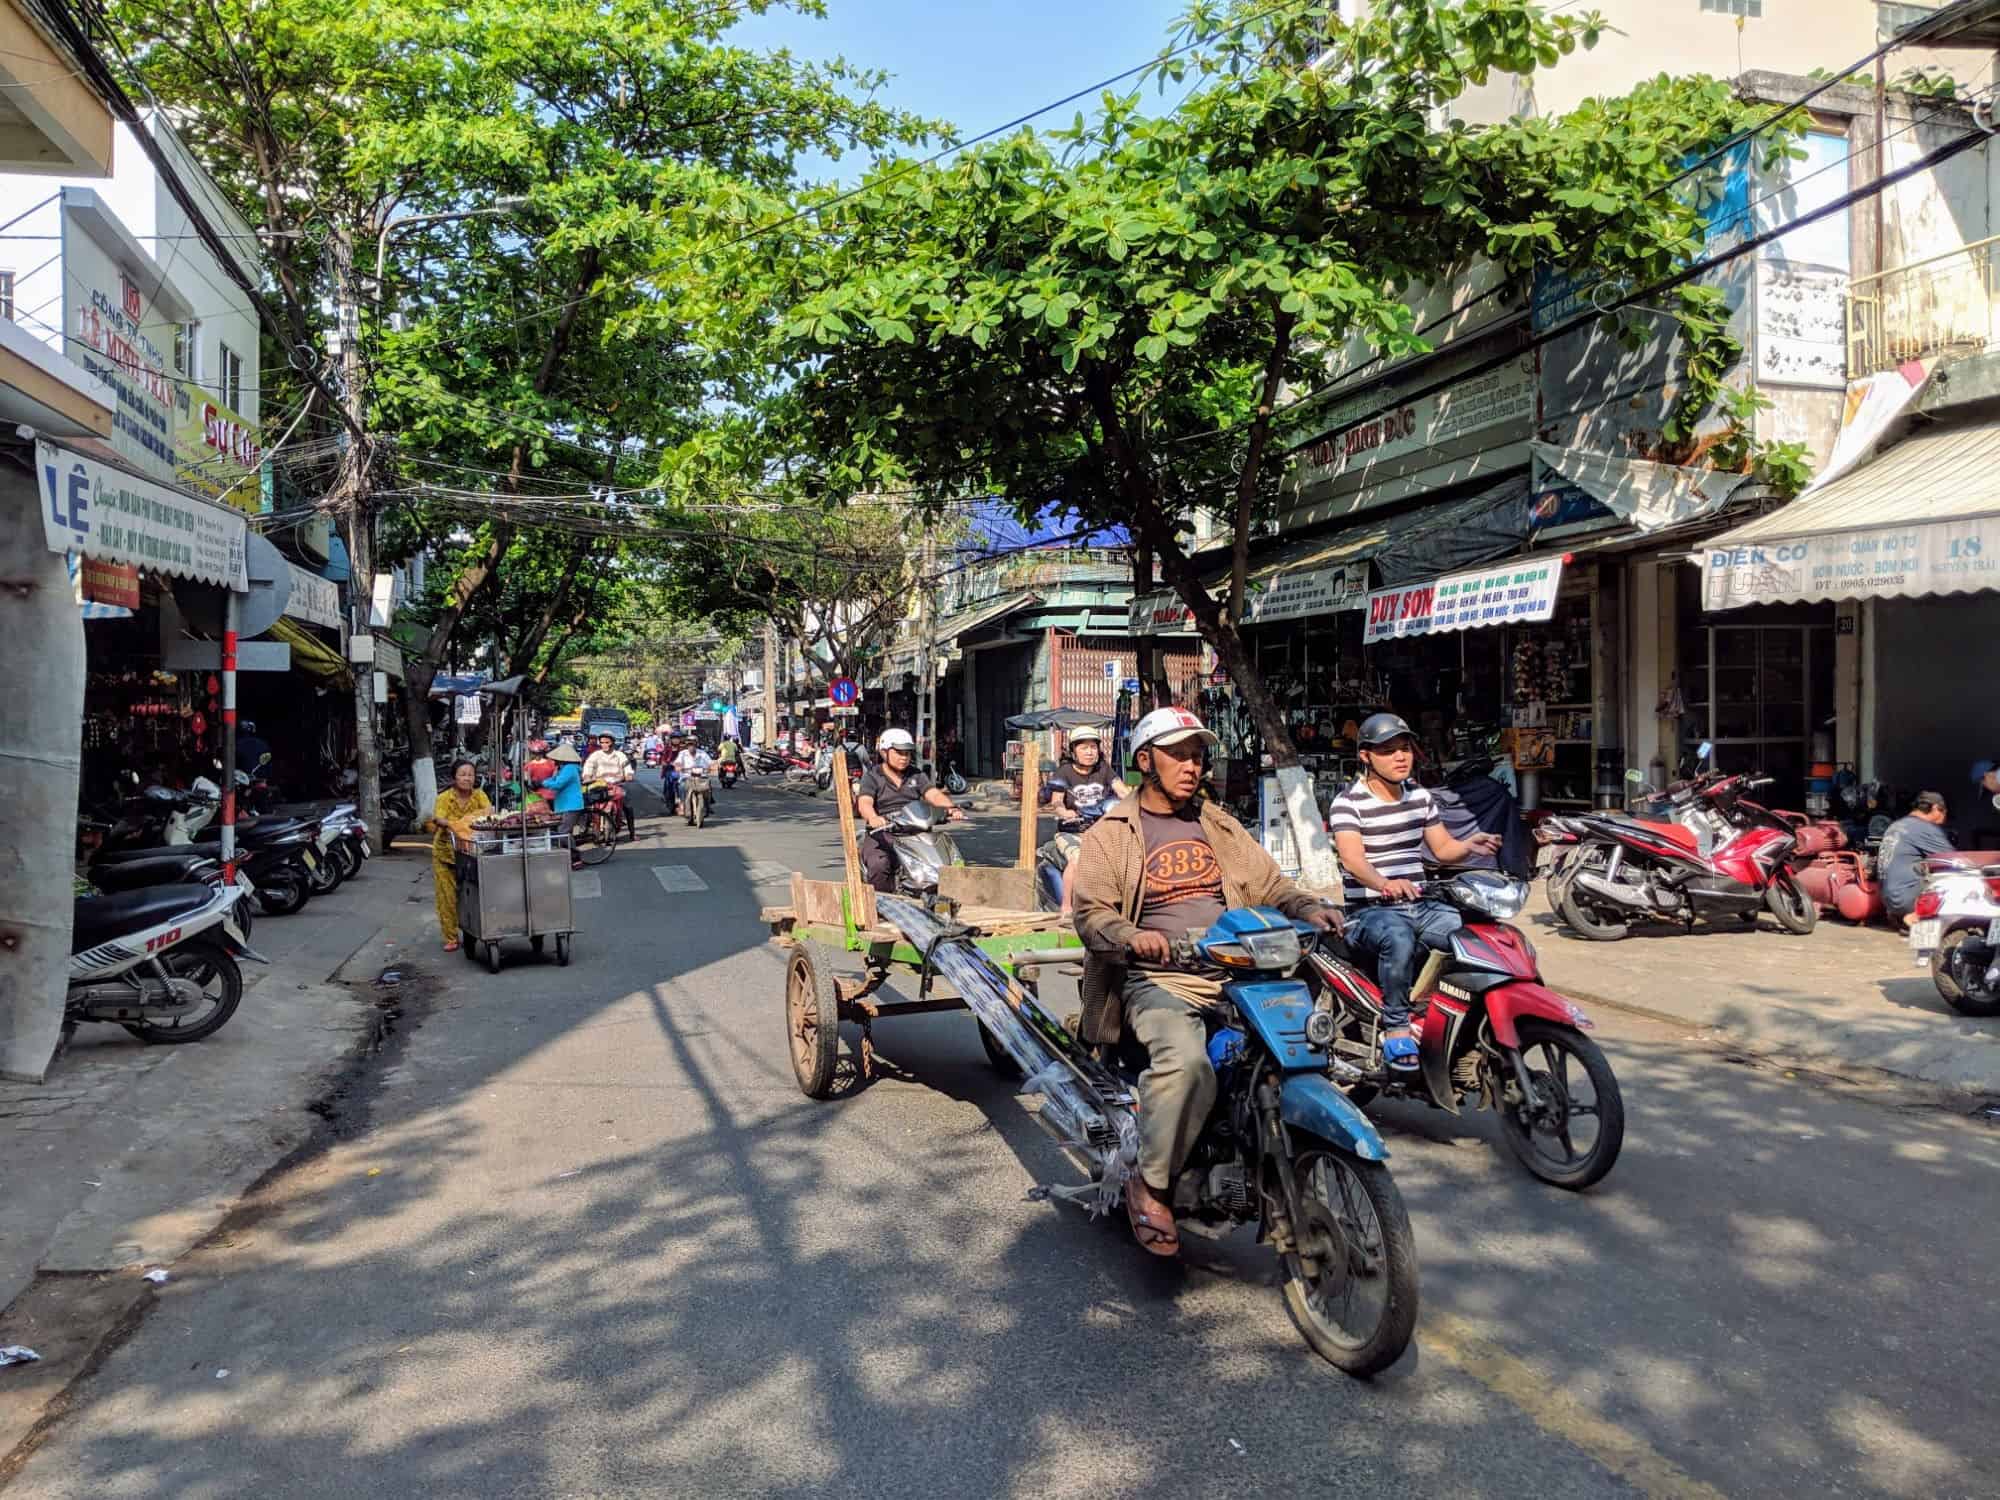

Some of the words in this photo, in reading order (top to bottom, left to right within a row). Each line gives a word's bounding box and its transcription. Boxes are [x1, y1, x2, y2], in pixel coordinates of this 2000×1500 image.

[93, 289, 123, 329] CÔNG
[81, 304, 100, 349] LÊ
[1345, 421, 1380, 457] MINH
[45, 464, 89, 544] LỆ
[1949, 535, 1982, 559] 18
[1370, 594, 1400, 625] DUY
[1158, 846, 1206, 878] 333
[145, 928, 182, 952] 110
[1439, 980, 1471, 1002] YAMAHA
